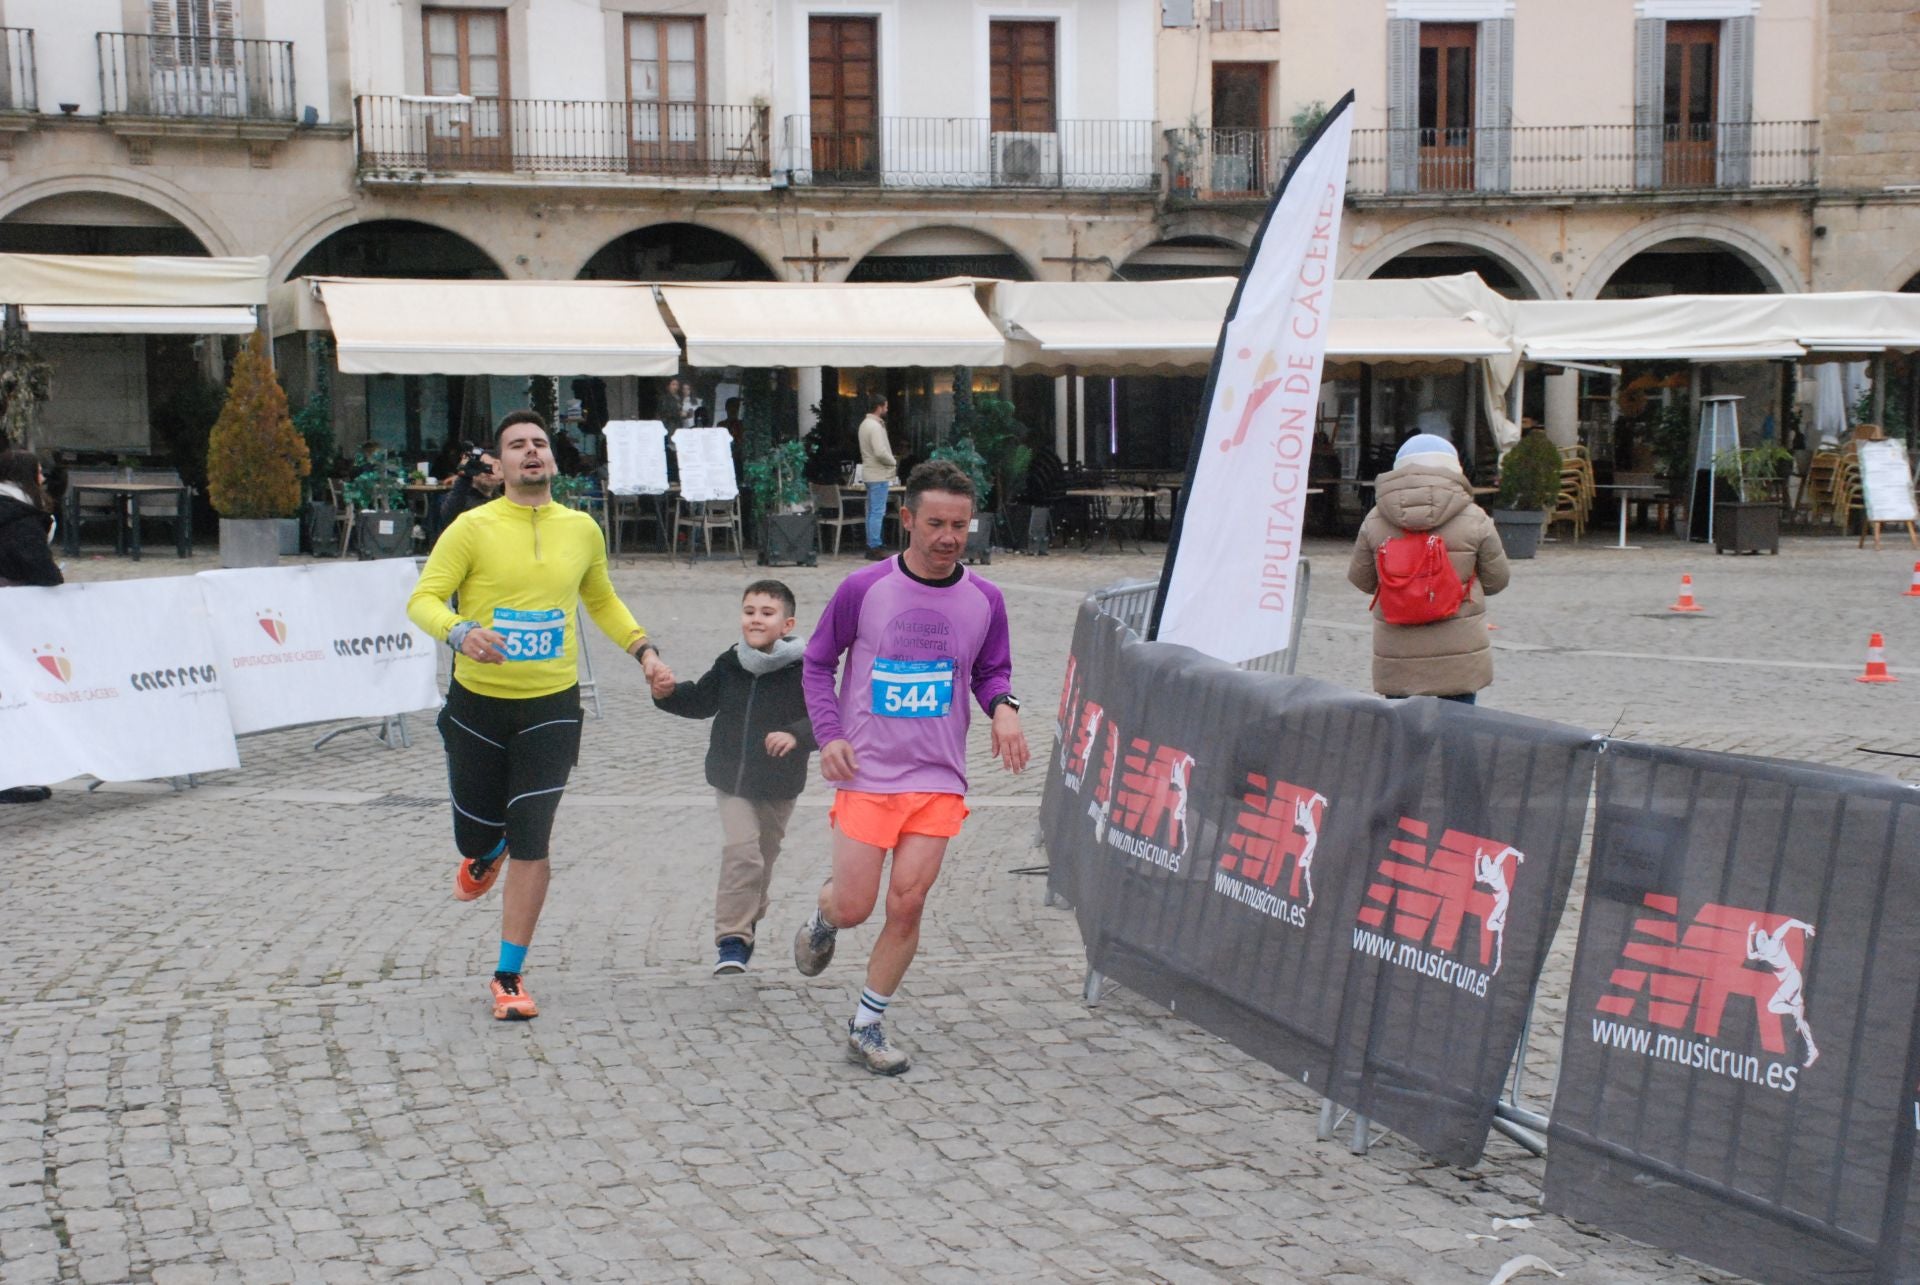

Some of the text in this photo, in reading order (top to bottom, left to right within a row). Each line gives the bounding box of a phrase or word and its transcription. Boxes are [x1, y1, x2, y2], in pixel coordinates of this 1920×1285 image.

[1259, 407, 1307, 612] DIPUTACIÓN
[1284, 354, 1314, 394] DE
[506, 631, 552, 657] 538
[893, 636, 948, 652] Montserrat
[895, 620, 950, 636] Matagalls
[884, 684, 938, 712] 544
[1108, 827, 1181, 873] www.musicrun.es
[1214, 871, 1306, 928] www.musicrun.es
[1352, 928, 1490, 998] www.musicrun.es
[1592, 1018, 1799, 1092] www.musicrun.es
